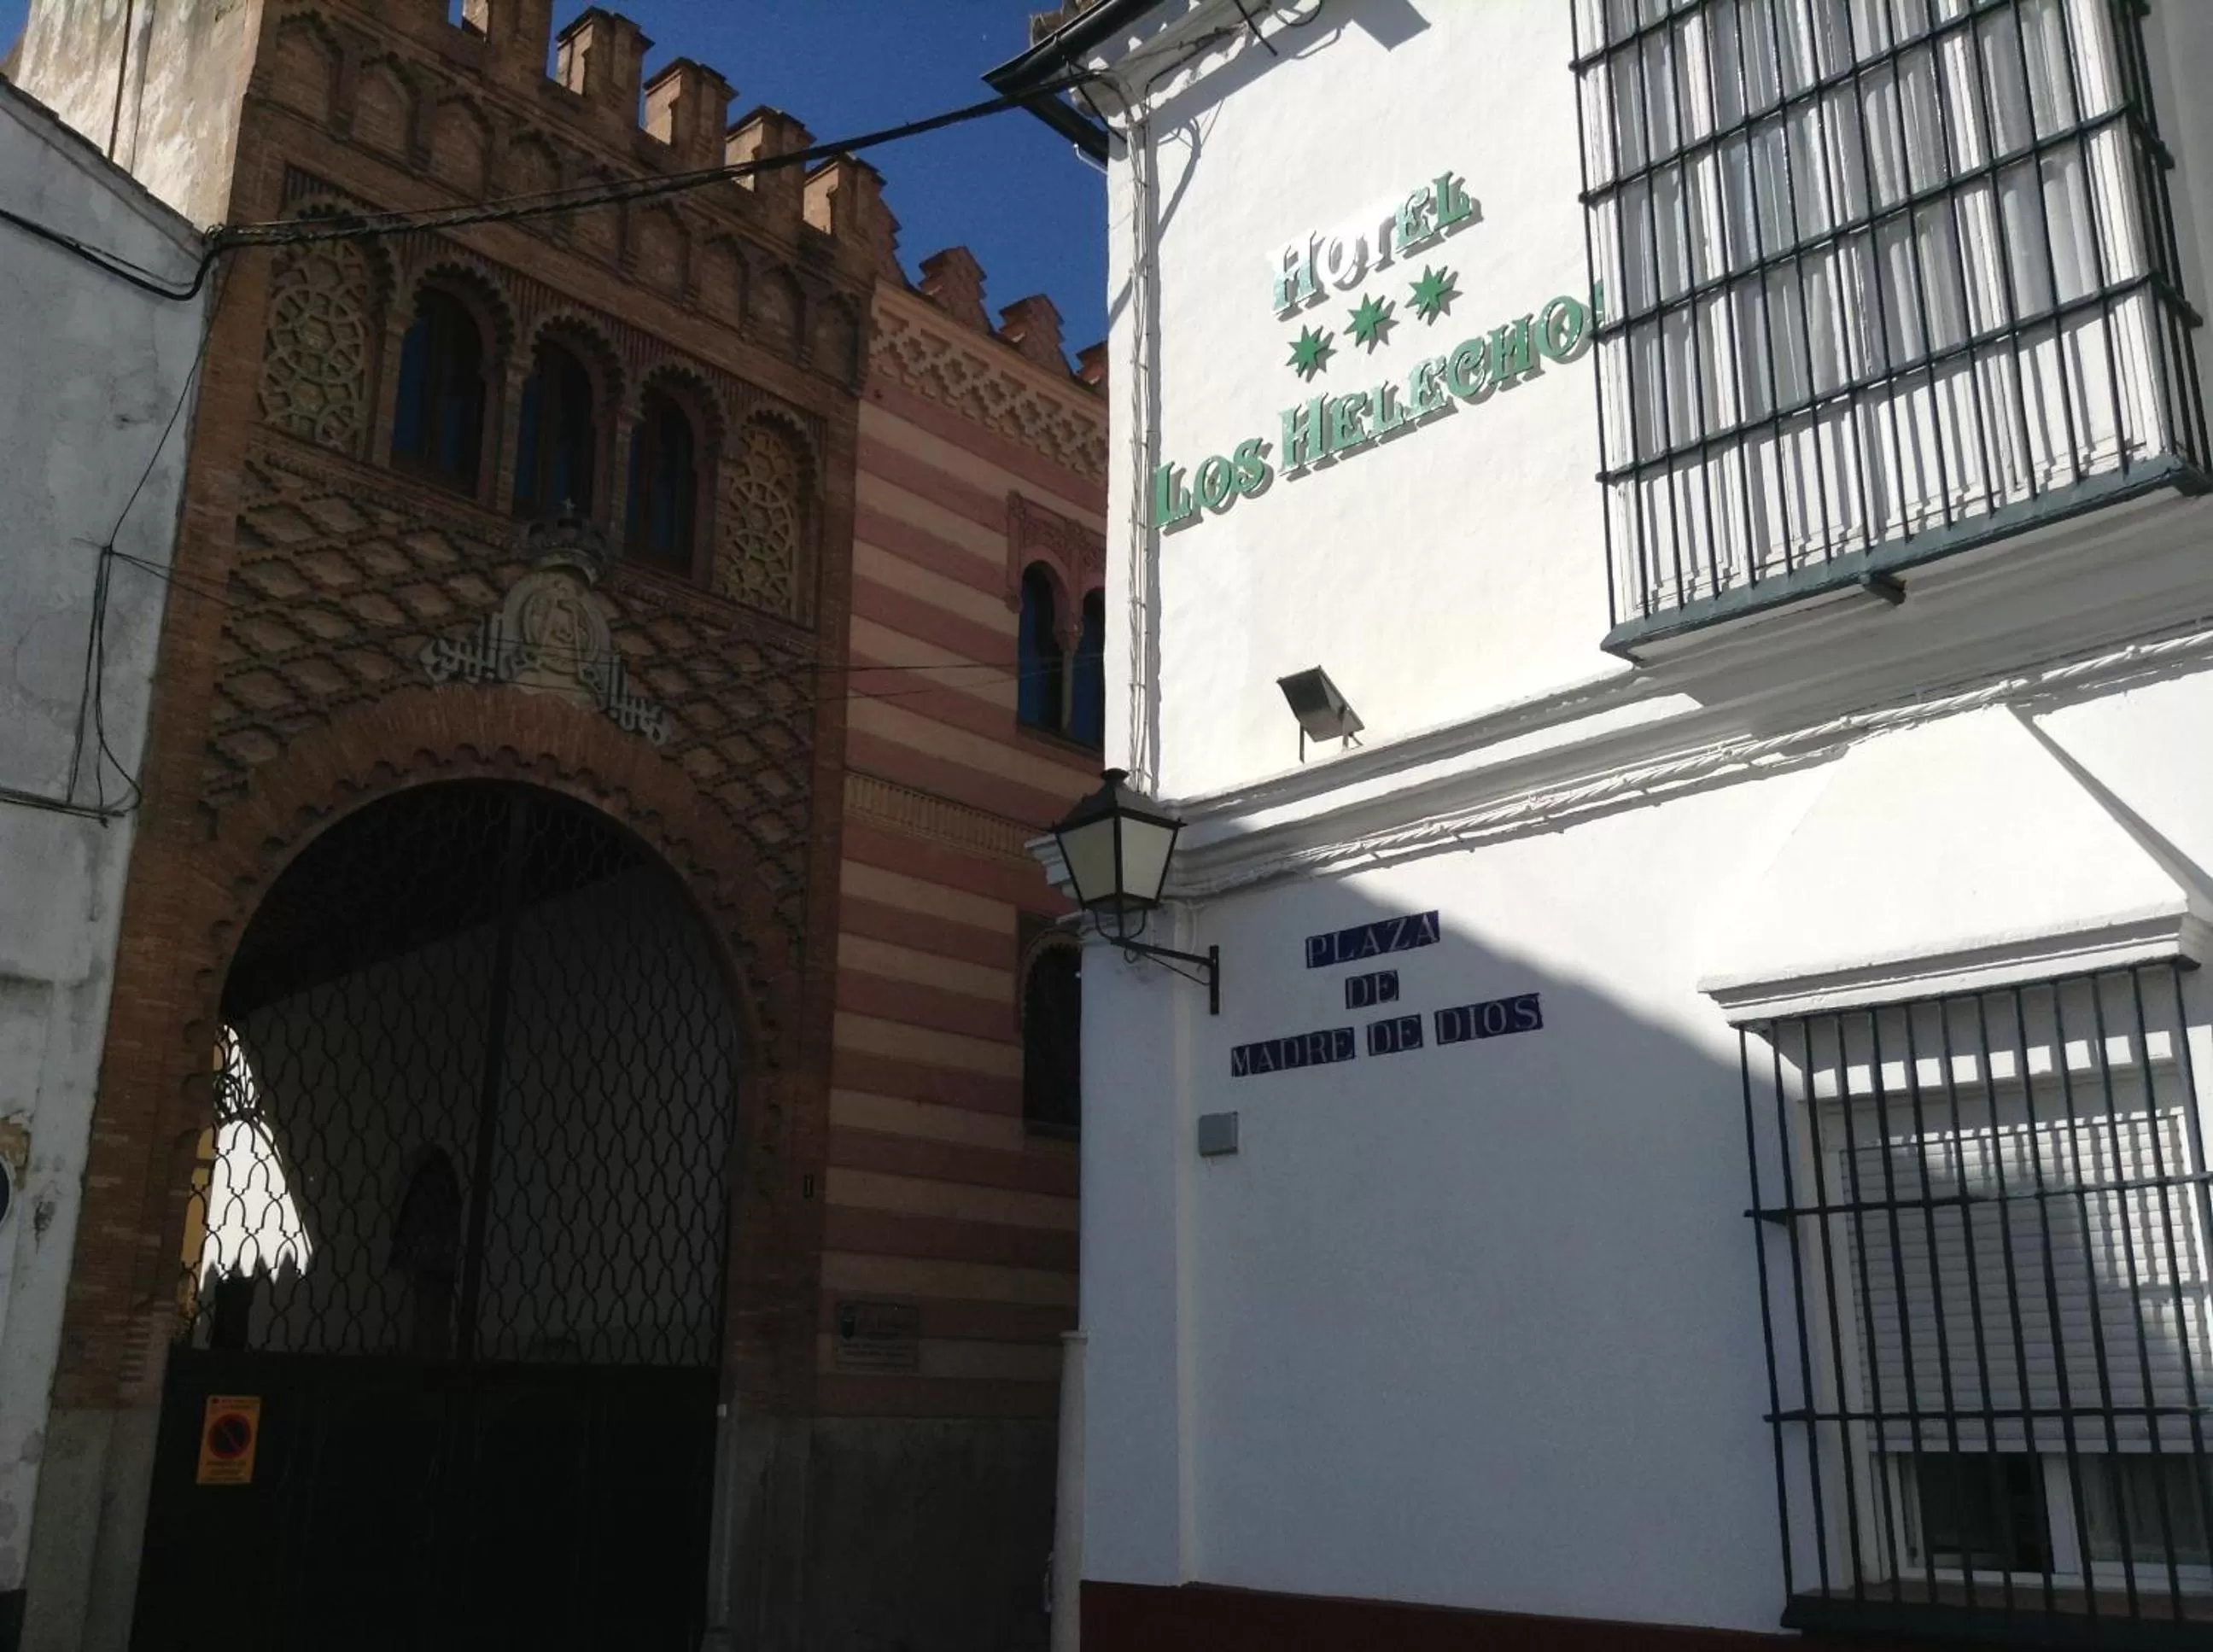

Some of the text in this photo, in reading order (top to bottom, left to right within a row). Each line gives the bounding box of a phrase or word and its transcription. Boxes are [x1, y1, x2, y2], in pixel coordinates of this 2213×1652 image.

[1270, 172, 1473, 315] HOTEL
[1154, 437, 1265, 529] LOS
[1309, 914, 1438, 966] PLAZA
[1348, 972, 1398, 1007] DE
[1233, 997, 1540, 1076] MADRE DE DIOS
